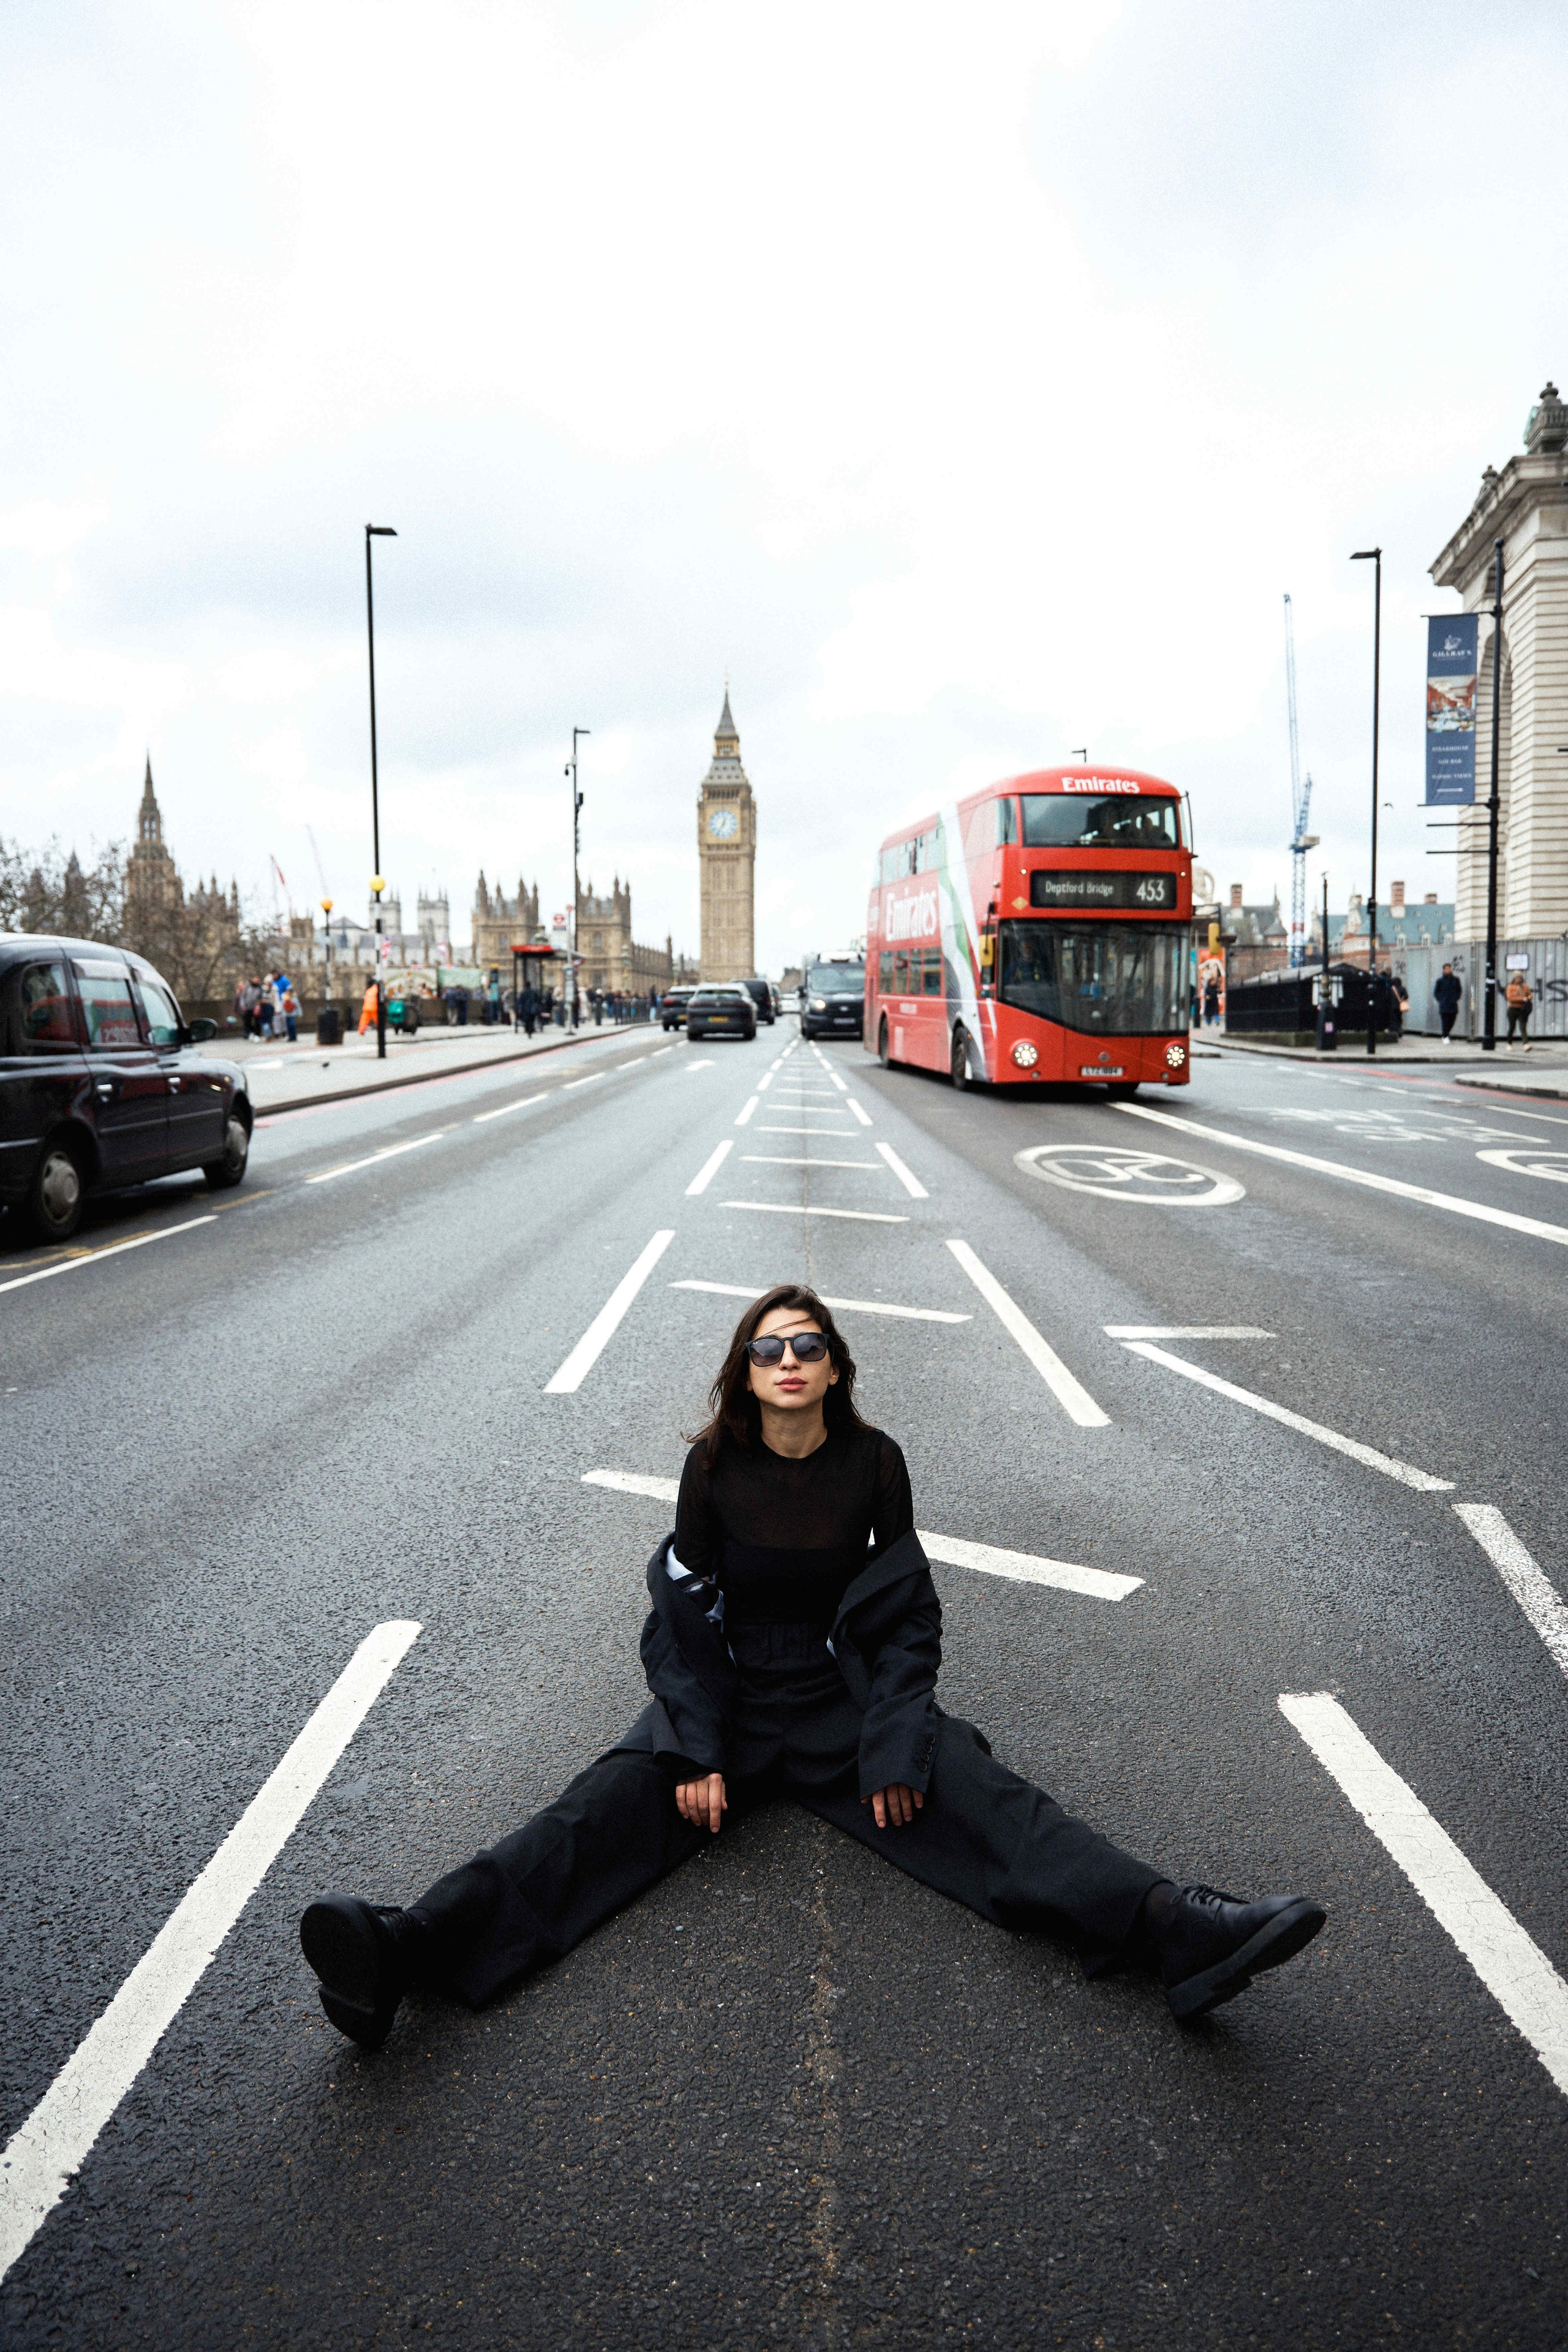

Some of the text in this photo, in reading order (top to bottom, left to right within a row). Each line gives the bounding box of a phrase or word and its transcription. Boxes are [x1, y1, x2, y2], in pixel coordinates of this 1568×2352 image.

[1061, 776, 1140, 790] Emirates
[1046, 880, 1166, 902] Deptford Bridge 453
[886, 886, 936, 941] Emirates
[1041, 1158, 1206, 1182] 20
